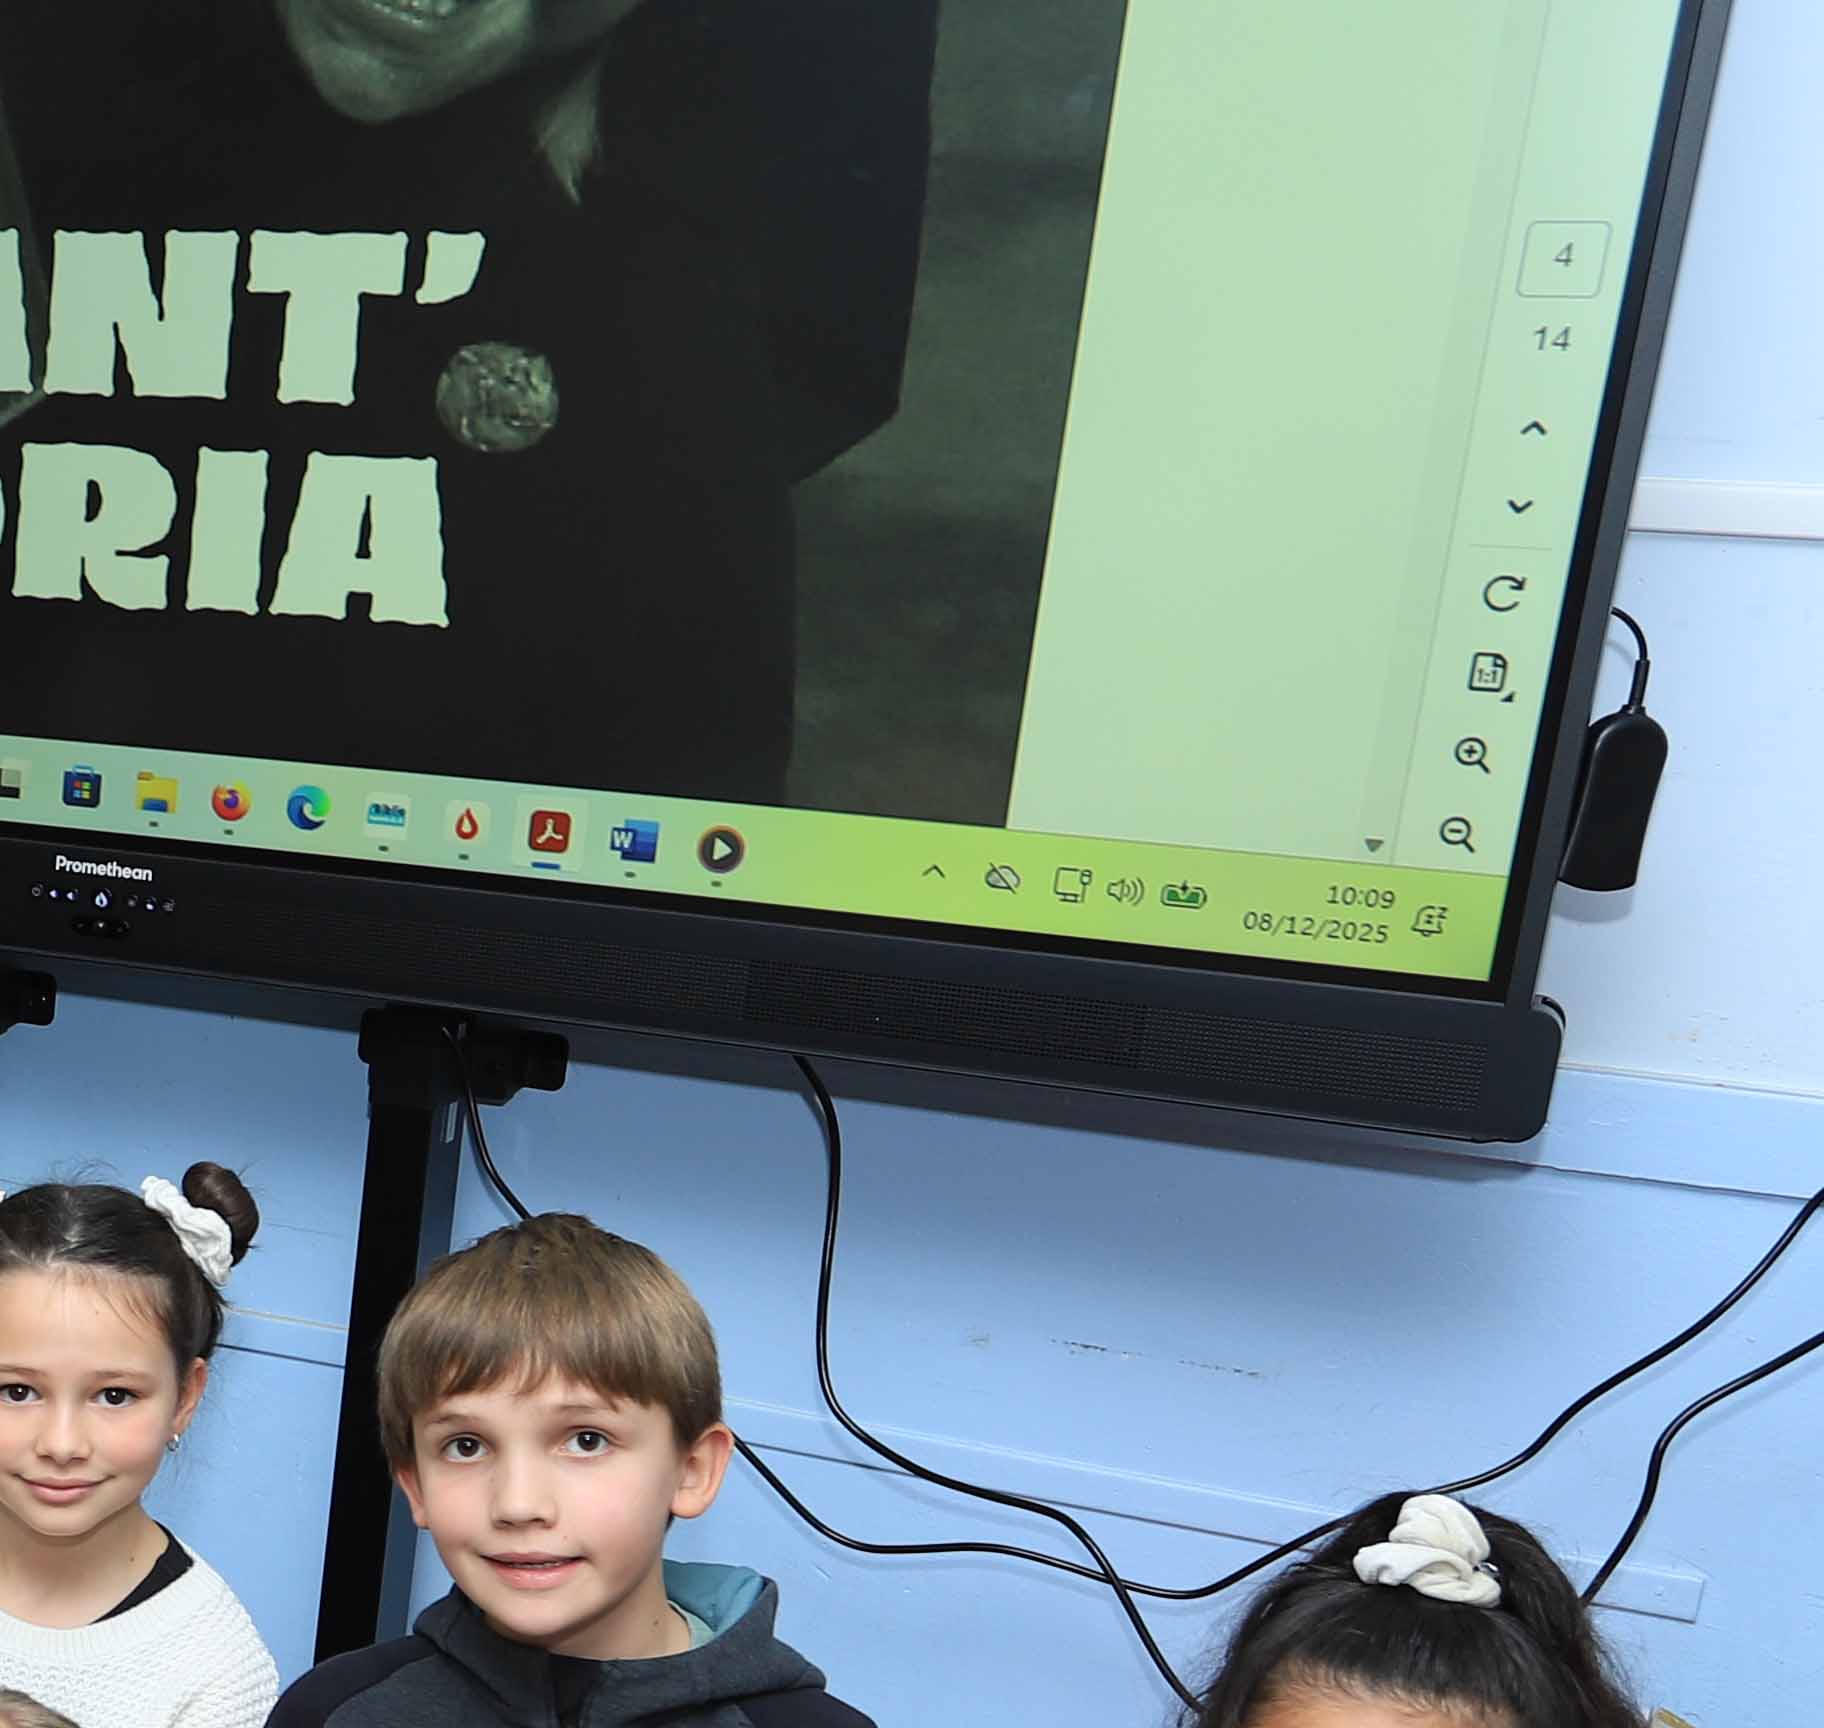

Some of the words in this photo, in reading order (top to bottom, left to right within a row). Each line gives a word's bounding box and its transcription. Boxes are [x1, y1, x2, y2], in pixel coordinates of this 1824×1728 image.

[1553, 242, 1575, 268] 4
[1533, 326, 1572, 353] 14
[54, 853, 154, 884] Promethean
[1326, 882, 1397, 911] 10:09
[1243, 909, 1390, 945] 08/12/2025
